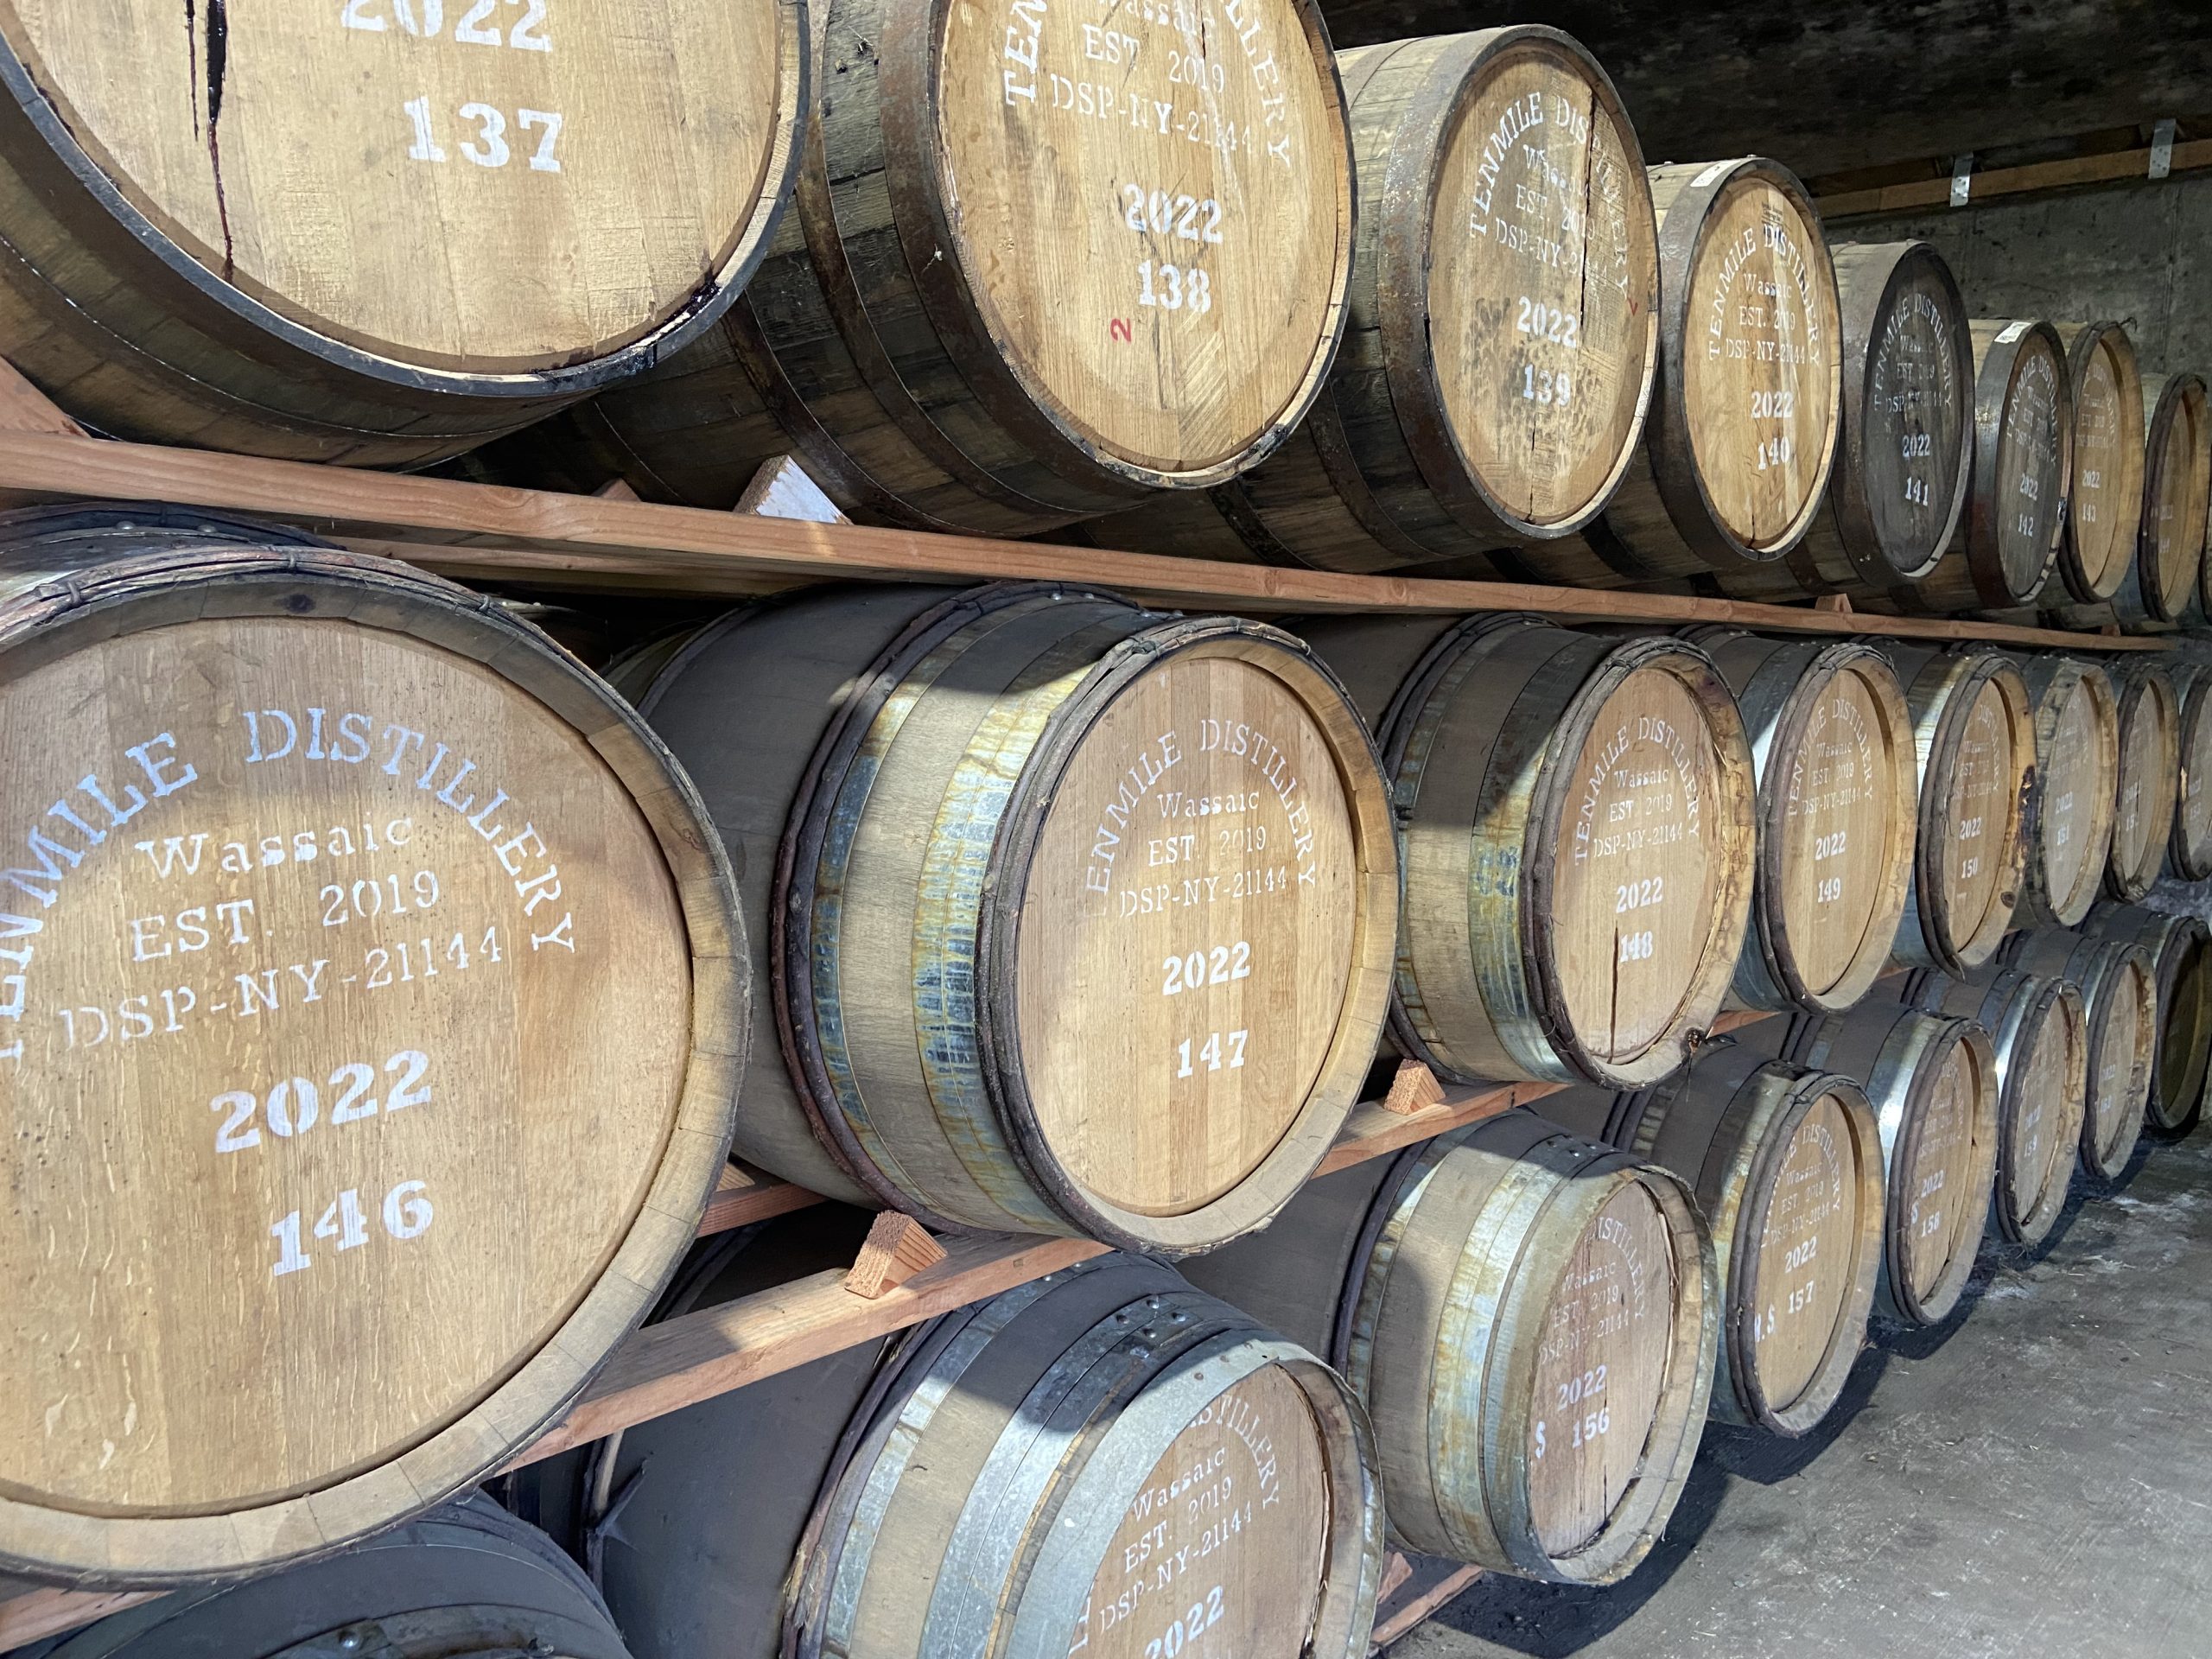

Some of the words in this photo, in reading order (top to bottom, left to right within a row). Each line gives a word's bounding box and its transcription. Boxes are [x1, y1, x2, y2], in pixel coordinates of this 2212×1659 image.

[1168, 50, 1224, 94] 2019
[404, 95, 563, 174] 137
[1469, 92, 1544, 238] TENMILE
[1123, 184, 1224, 245] 2022
[1138, 259, 1211, 314] 138
[1709, 227, 1757, 360] TENMILE
[1764, 224, 1821, 366] DISTILLERY
[1516, 296, 1577, 349] 2022
[1874, 297, 1910, 411] TENMILE
[1523, 364, 1571, 406] 139
[1751, 391, 1794, 418] 2022
[1758, 436, 1790, 470] 140
[1903, 434, 1930, 457] 2022
[1905, 476, 1929, 506] 141
[2019, 472, 2038, 501] 2022
[2082, 469, 2101, 489] 2022
[2018, 512, 2034, 537] 142
[1832, 698, 1872, 800] DISTILLERY
[1574, 726, 1629, 867] TENMILE
[1638, 717, 1700, 837] DISTILLERY
[1614, 769, 1669, 789] Wassaic
[1157, 791, 1260, 818] Wassaic
[1200, 719, 1316, 887] DISTILLERY
[1645, 794, 1673, 815] 2019
[2056, 791, 2073, 815] 2022
[135, 812, 413, 878] Wassaic
[243, 708, 575, 954] DISTILLERY
[1219, 825, 1267, 855] 2019
[1593, 823, 1682, 858] DSP-NY-21144
[1815, 831, 1847, 860] 2022
[1960, 816, 1981, 841] 2022
[1961, 856, 1979, 879] 150
[321, 870, 440, 927] 2019
[1119, 866, 1287, 918] DSP-NY-21144
[1616, 876, 1662, 913] 2022
[1818, 877, 1841, 904] 149
[1162, 941, 1251, 996] 2022
[1620, 931, 1654, 963] 148
[59, 926, 503, 1053] DSP-NY-21144
[1177, 1029, 1249, 1079] 147
[211, 1050, 431, 1154] 2022
[1921, 1169, 1943, 1198] 2022
[272, 1180, 434, 1277] 146
[1785, 1236, 1816, 1274] 2022
[1789, 1280, 1814, 1313] 157
[1558, 1365, 1606, 1412] 2022
[1573, 1408, 1610, 1449] 156
[1190, 1394, 1279, 1510] STILLERY
[1133, 1447, 1226, 1522] Wassaic
[1188, 1476, 1232, 1526] 2019
[1100, 1500, 1252, 1637] DSP-NY-21144
[1144, 1585, 1225, 1659] 2022
